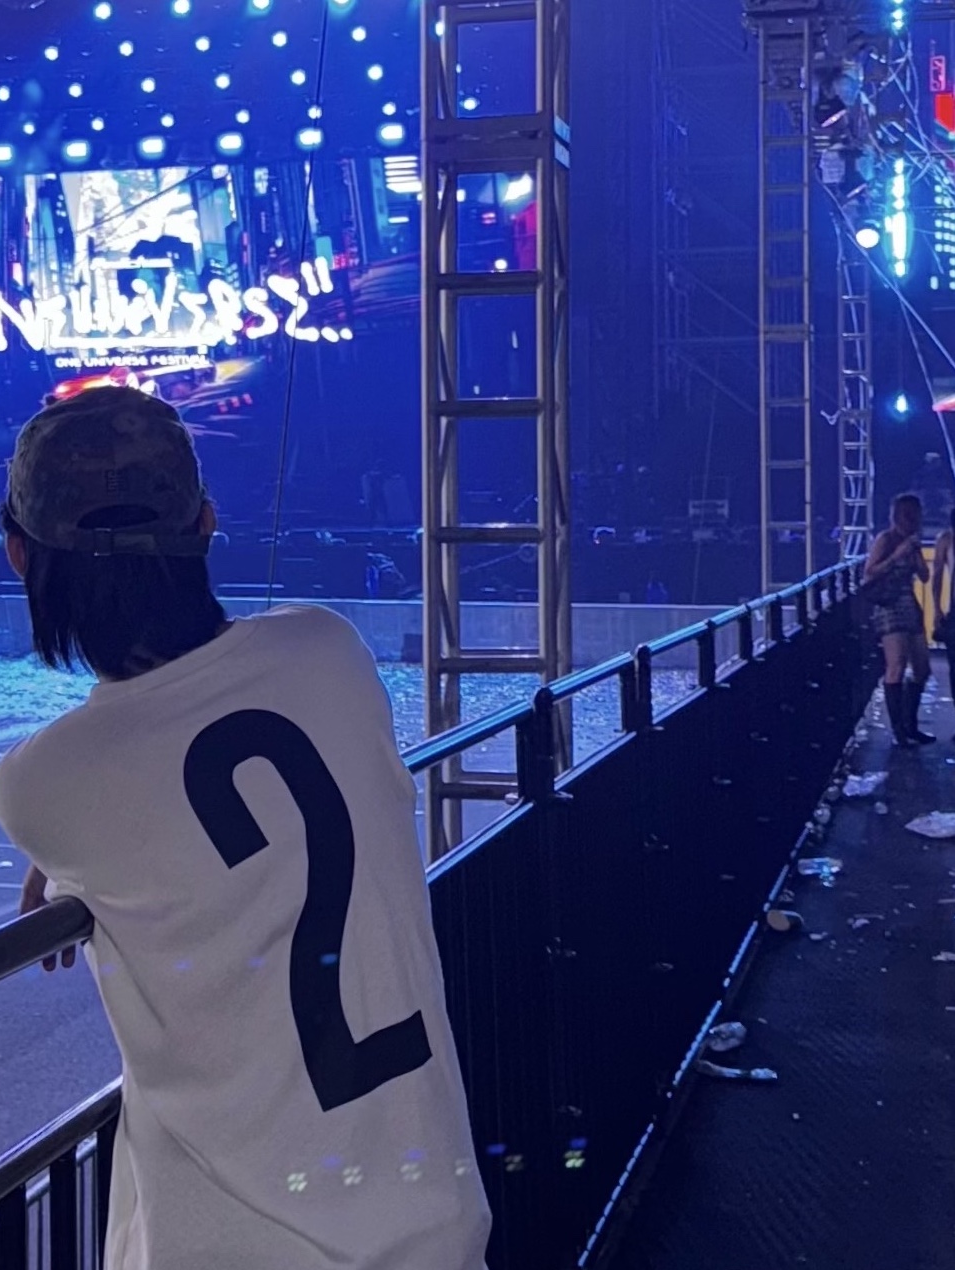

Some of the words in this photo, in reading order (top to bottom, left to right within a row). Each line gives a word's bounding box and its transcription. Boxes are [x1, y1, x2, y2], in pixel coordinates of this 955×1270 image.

[55, 357, 81, 368] ONE
[84, 355, 147, 368] UNIVERSE
[151, 354, 210, 366] FESTIVAL
[183, 708, 433, 1113] 2
